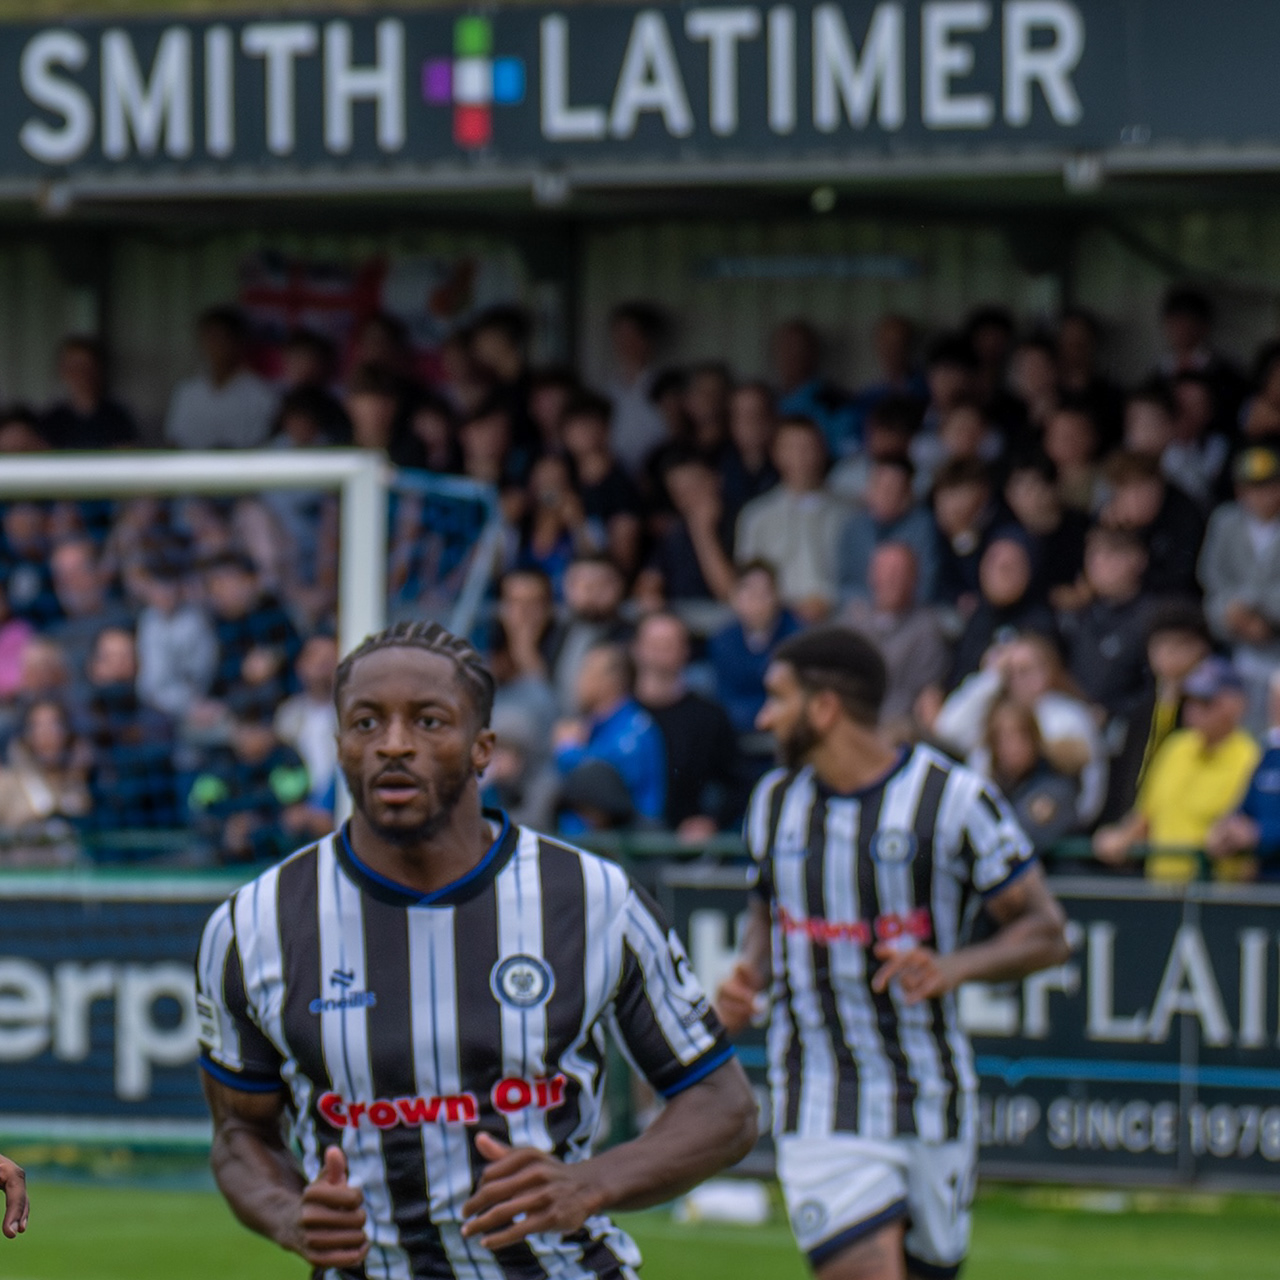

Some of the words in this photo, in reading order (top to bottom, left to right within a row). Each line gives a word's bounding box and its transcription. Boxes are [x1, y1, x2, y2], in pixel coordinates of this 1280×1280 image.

[20, 22, 406, 164] SMITH
[539, 0, 1088, 142] LATIMER
[318, 1090, 479, 1130] Crown
[1047, 1096, 1178, 1153] SINCE
